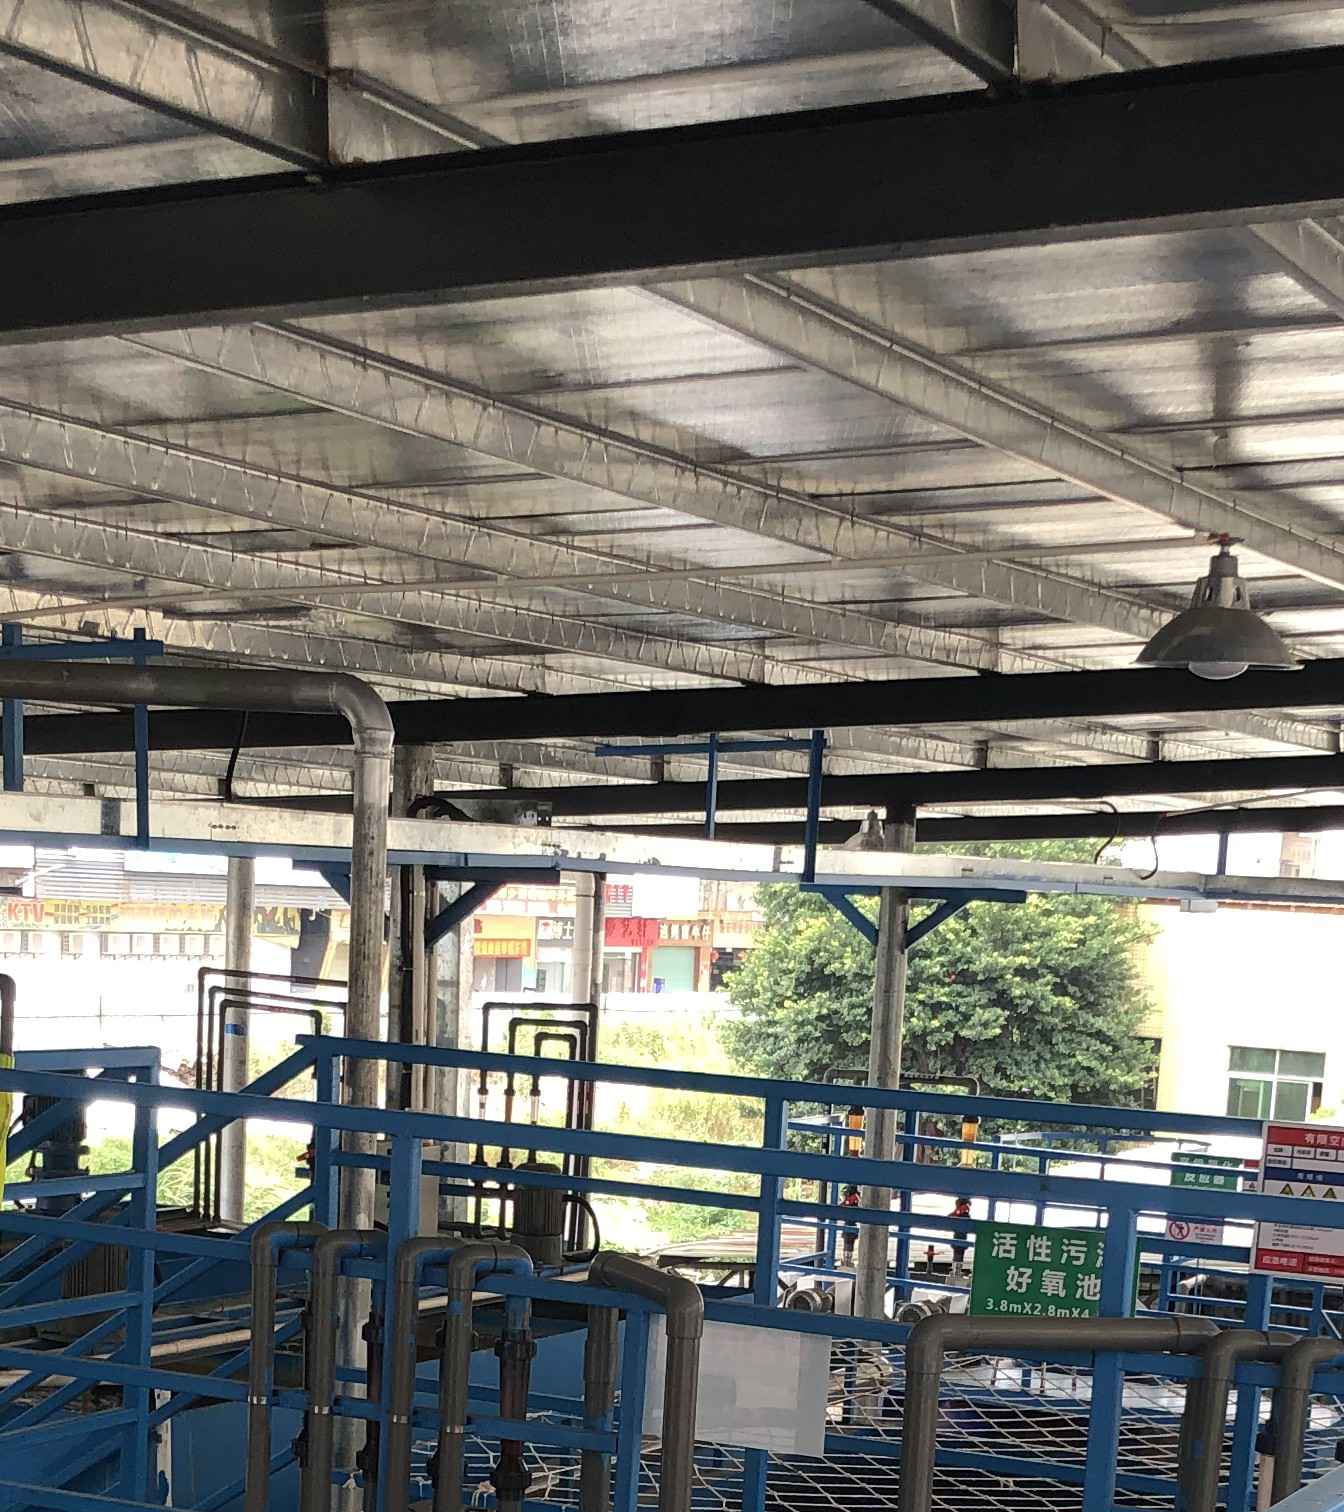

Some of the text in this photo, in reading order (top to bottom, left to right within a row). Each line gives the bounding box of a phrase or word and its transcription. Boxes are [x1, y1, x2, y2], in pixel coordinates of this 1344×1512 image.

[7, 901, 45, 923] KTV
[1006, 1265, 1100, 1301] 好氧池
